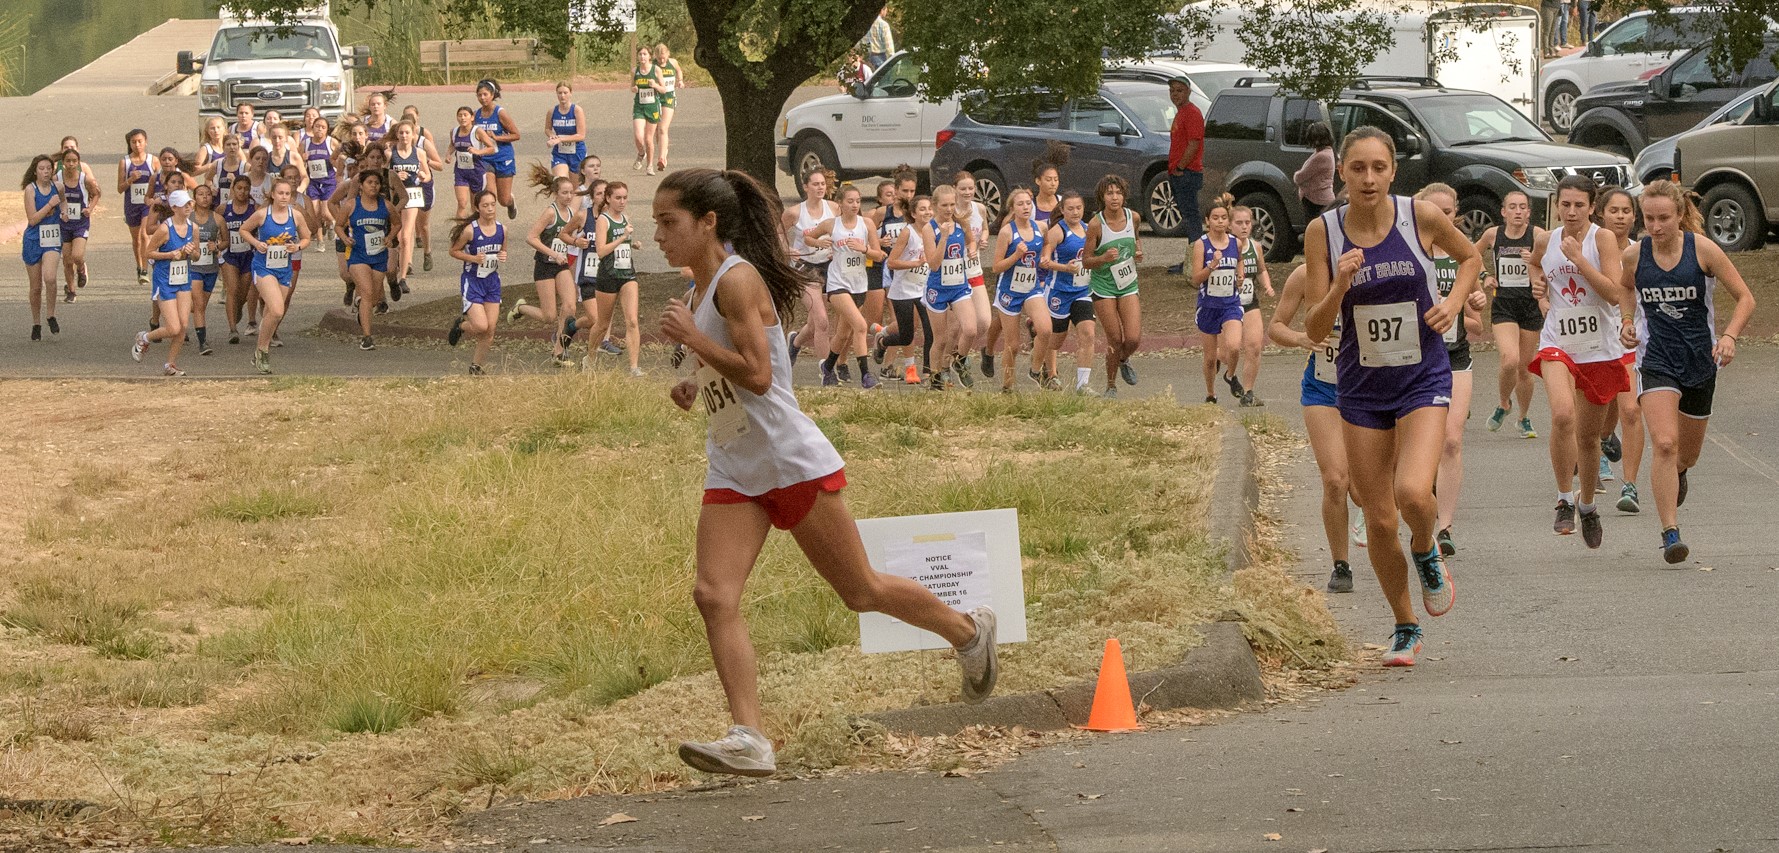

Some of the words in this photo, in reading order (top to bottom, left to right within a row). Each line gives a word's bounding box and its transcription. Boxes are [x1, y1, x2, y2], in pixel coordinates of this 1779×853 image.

[41, 229, 60, 239] 1013
[231, 236, 245, 244] 110
[268, 250, 288, 260] 1012
[846, 257, 861, 267] 960
[943, 264, 963, 275] 1043
[1117, 264, 1133, 279] 901
[1350, 266, 1372, 288] ORT
[1375, 261, 1415, 279] BRAGG
[1501, 265, 1527, 275] 1002
[1014, 272, 1036, 282] 1044
[1210, 275, 1233, 286] 1102
[1641, 286, 1697, 303] CREDO
[1368, 317, 1402, 342] 937
[1559, 315, 1598, 336] 1058
[919, 571, 973, 582] CHAMPIONSHIP
